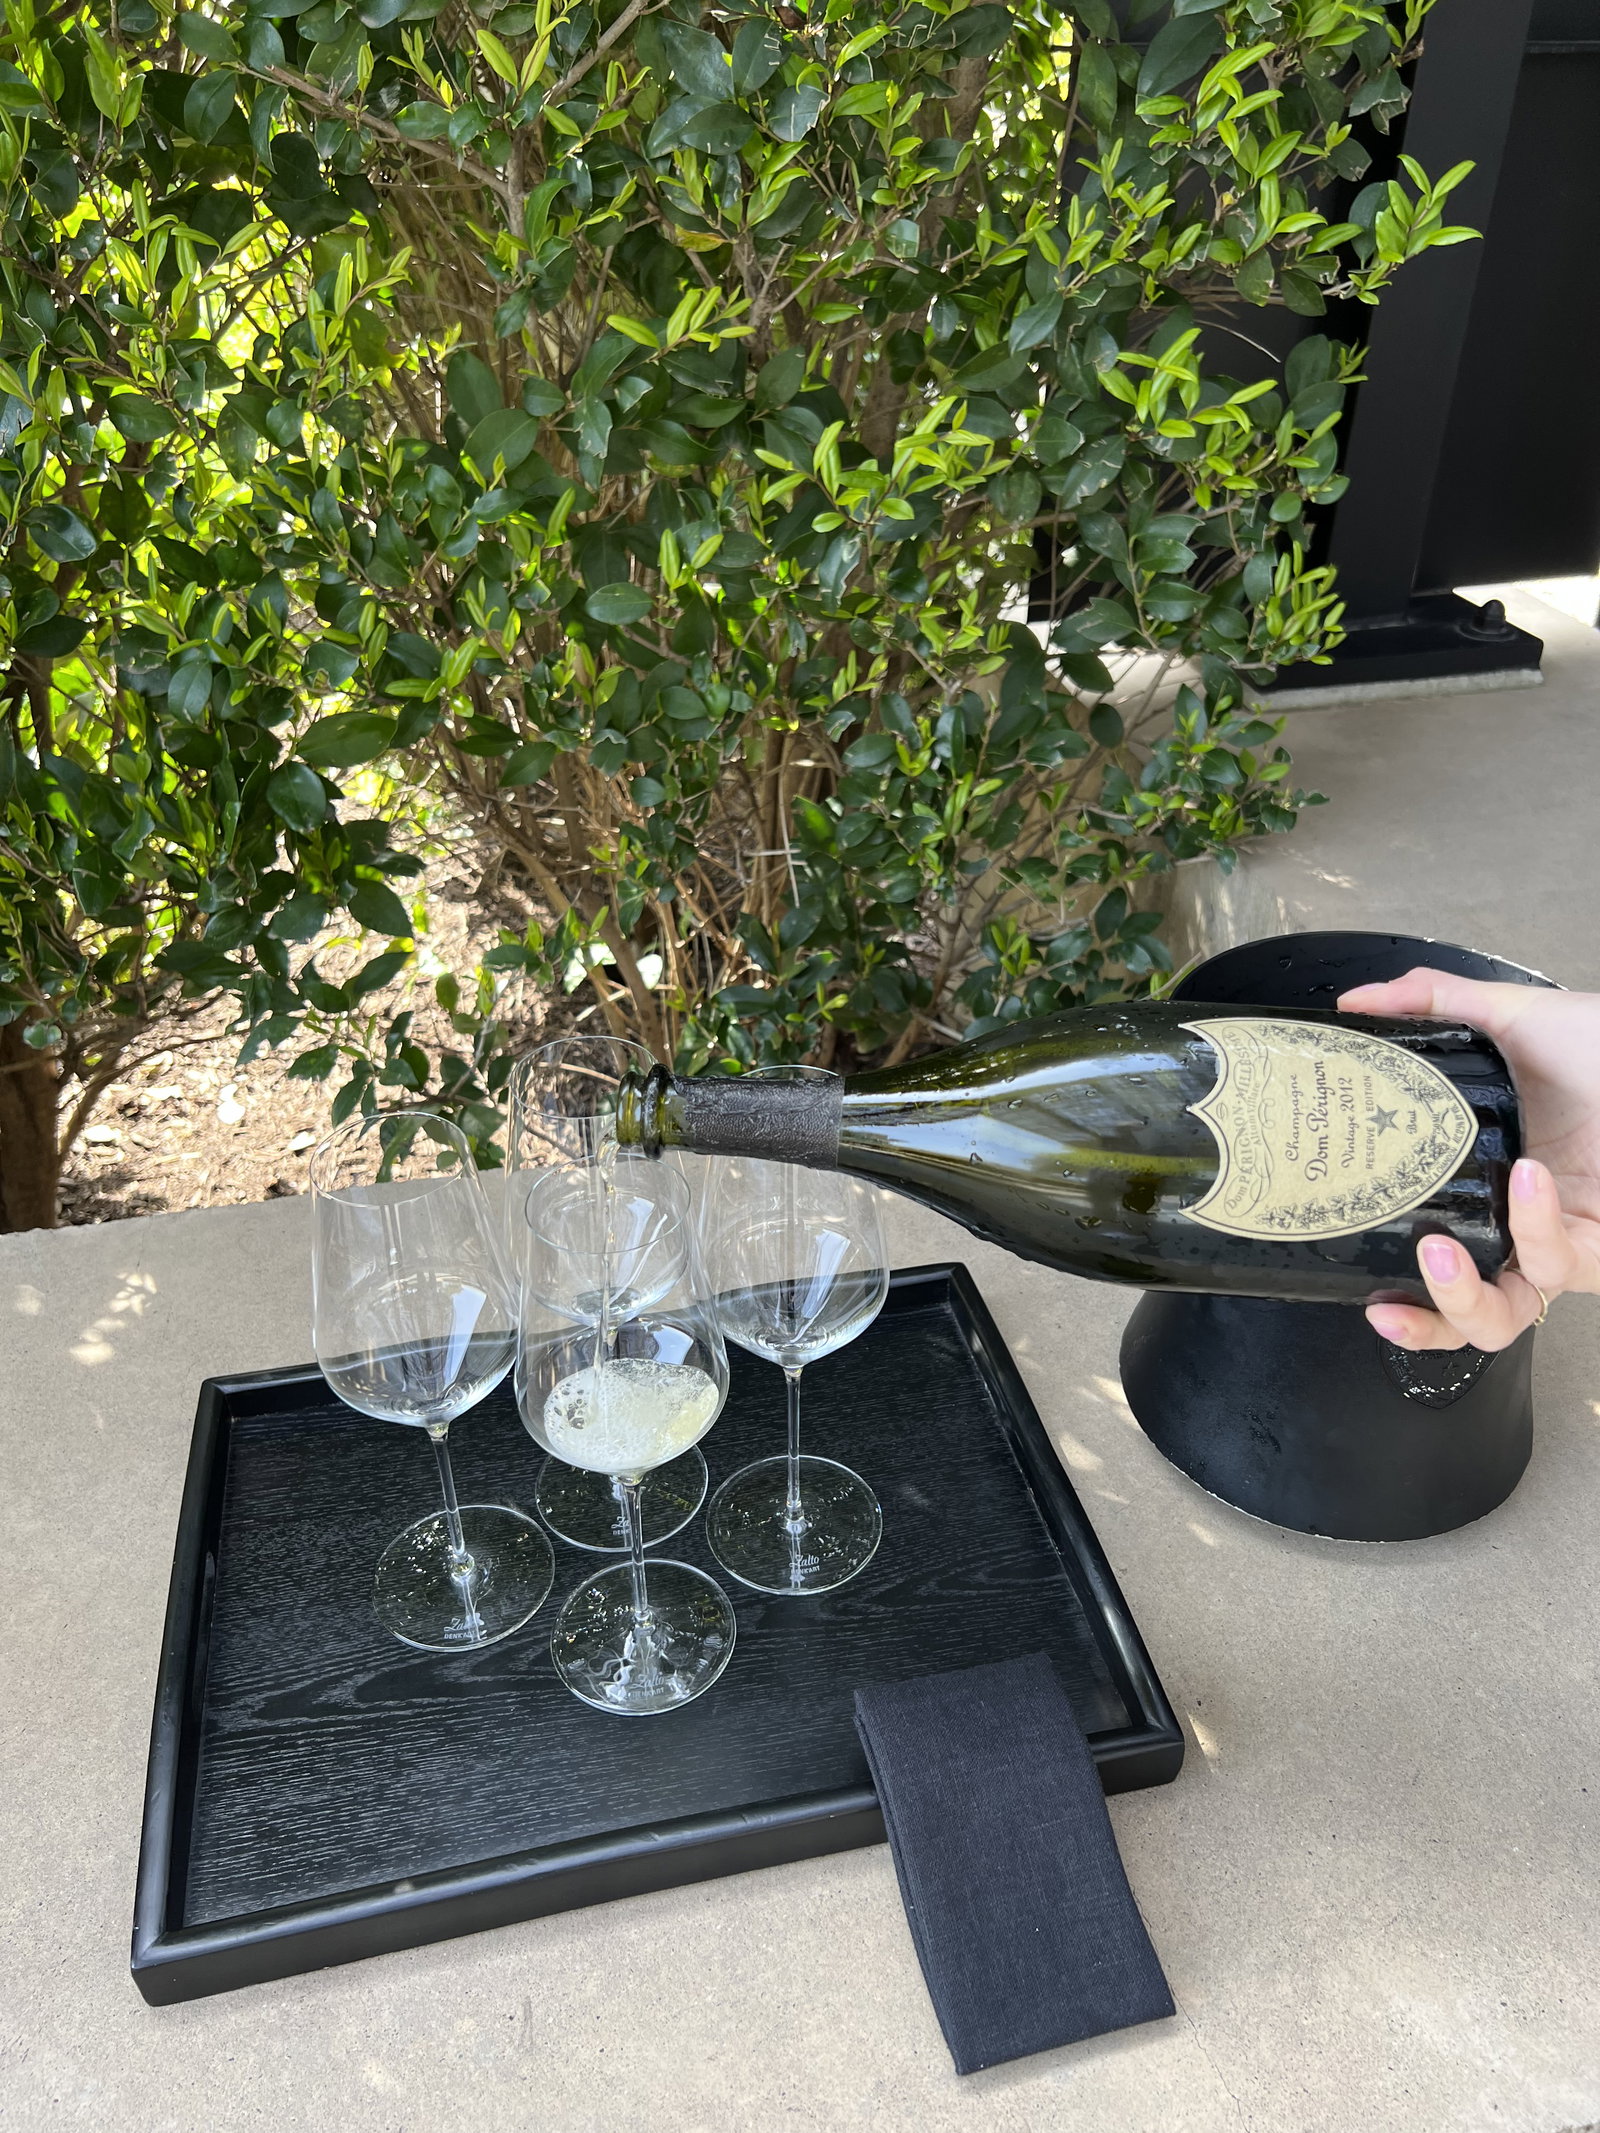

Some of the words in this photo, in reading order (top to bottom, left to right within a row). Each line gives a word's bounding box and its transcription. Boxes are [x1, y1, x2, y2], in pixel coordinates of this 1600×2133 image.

[1305, 1060, 1335, 1132] Pérignon
[1338, 1077, 1355, 1112] 2012
[1363, 1075, 1374, 1112] EDITION
[1285, 1074, 1304, 1161] Champagne
[1406, 1110, 1417, 1134] Brut
[1304, 1134, 1328, 1181] Dom
[1341, 1115, 1359, 1168] Vintage
[1365, 1126, 1375, 1170] RESERVE
[1226, 1186, 1248, 1209] Dom
